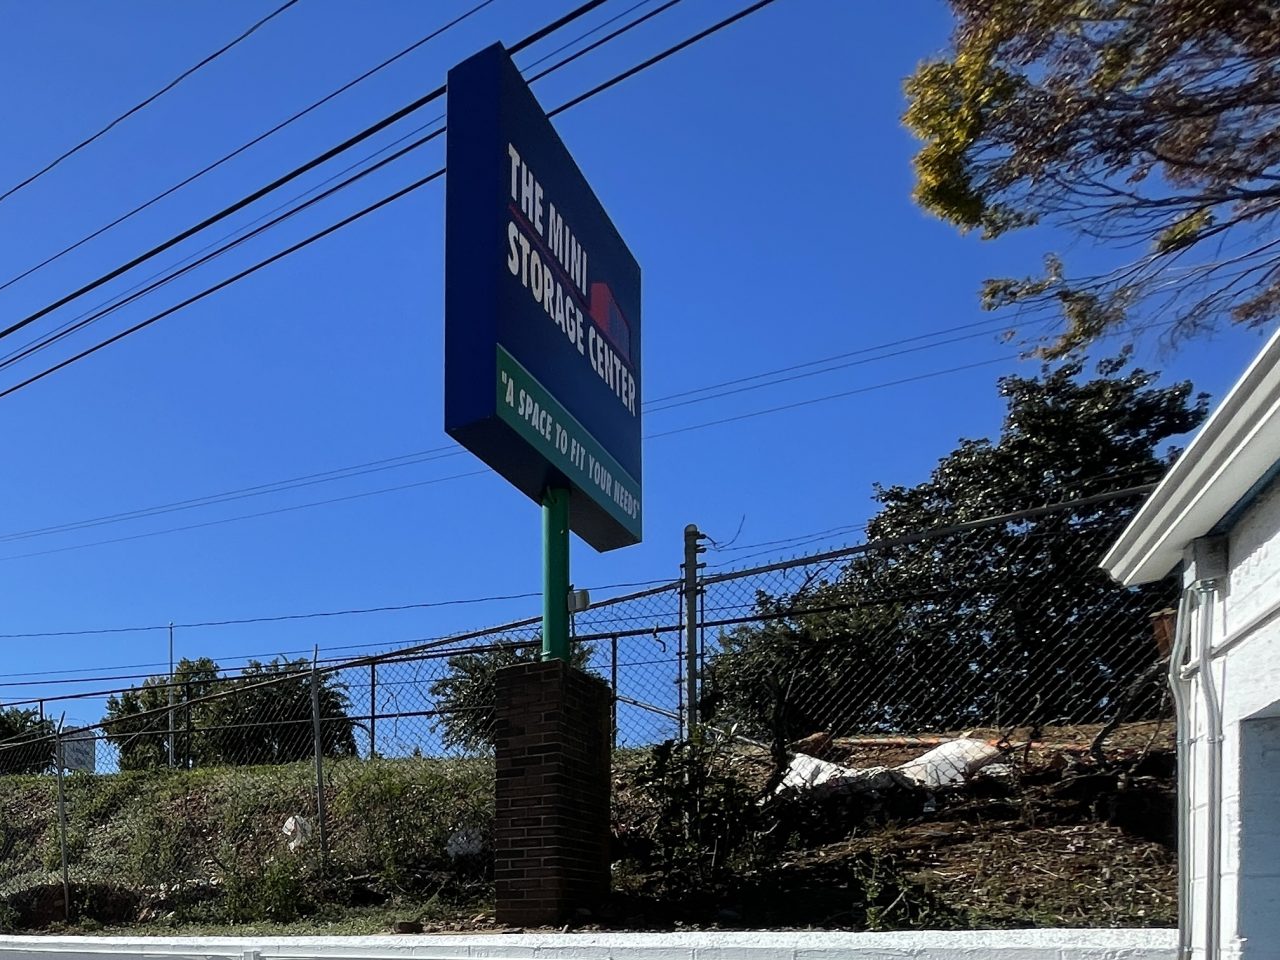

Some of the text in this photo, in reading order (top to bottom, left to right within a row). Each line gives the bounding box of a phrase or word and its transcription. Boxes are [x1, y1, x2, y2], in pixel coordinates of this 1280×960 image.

[508, 142, 587, 296] THE MINI
[507, 221, 636, 417] STORAGE CENTER
[518, 389, 552, 441] SPACE
[555, 422, 568, 455] TO
[570, 438, 586, 471] FIT
[588, 454, 612, 497] YOUR
